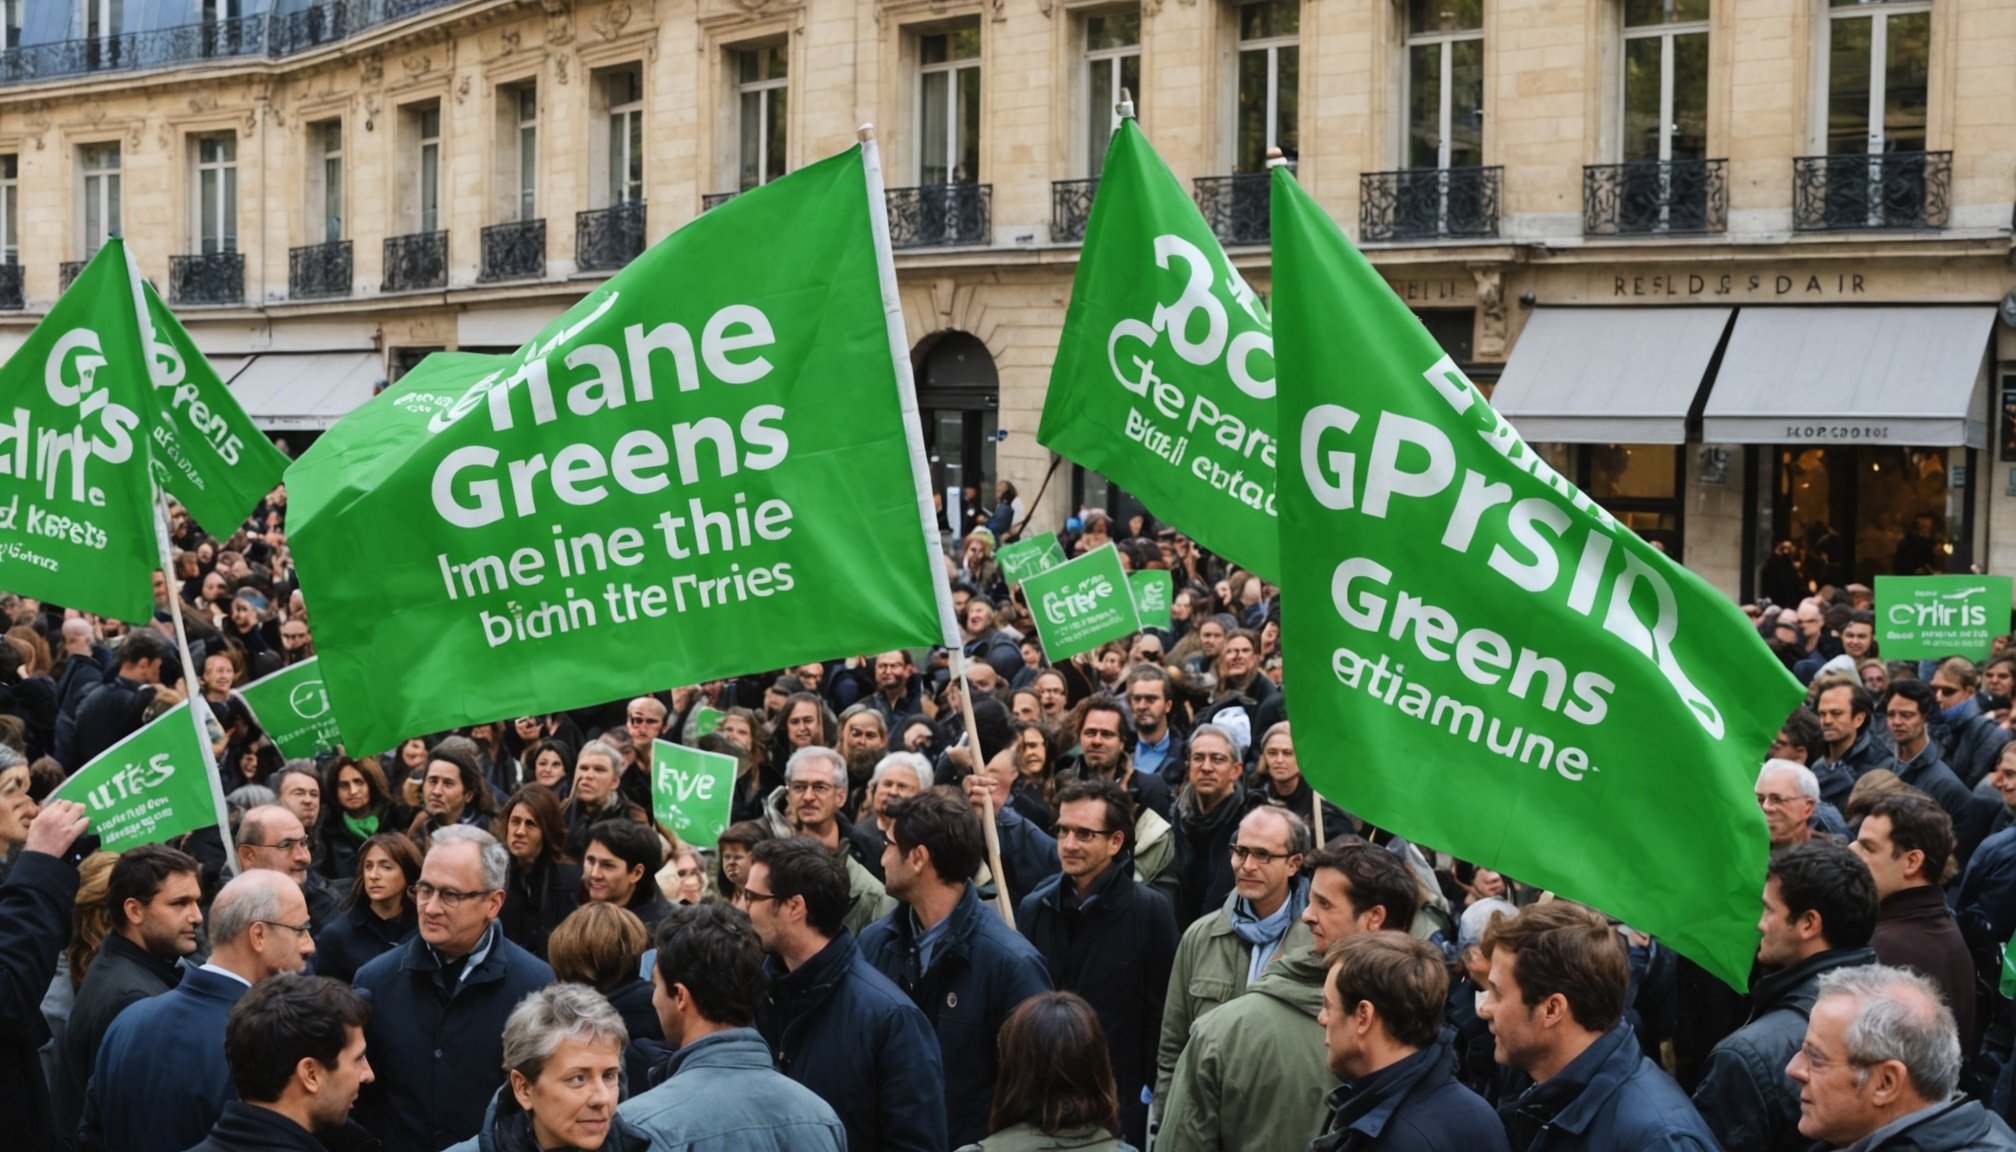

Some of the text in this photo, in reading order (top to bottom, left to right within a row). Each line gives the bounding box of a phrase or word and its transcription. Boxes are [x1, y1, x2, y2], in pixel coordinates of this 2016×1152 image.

[432, 404, 789, 529] Greens
[653, 492, 793, 560] thie
[1331, 557, 1616, 726] Greens
